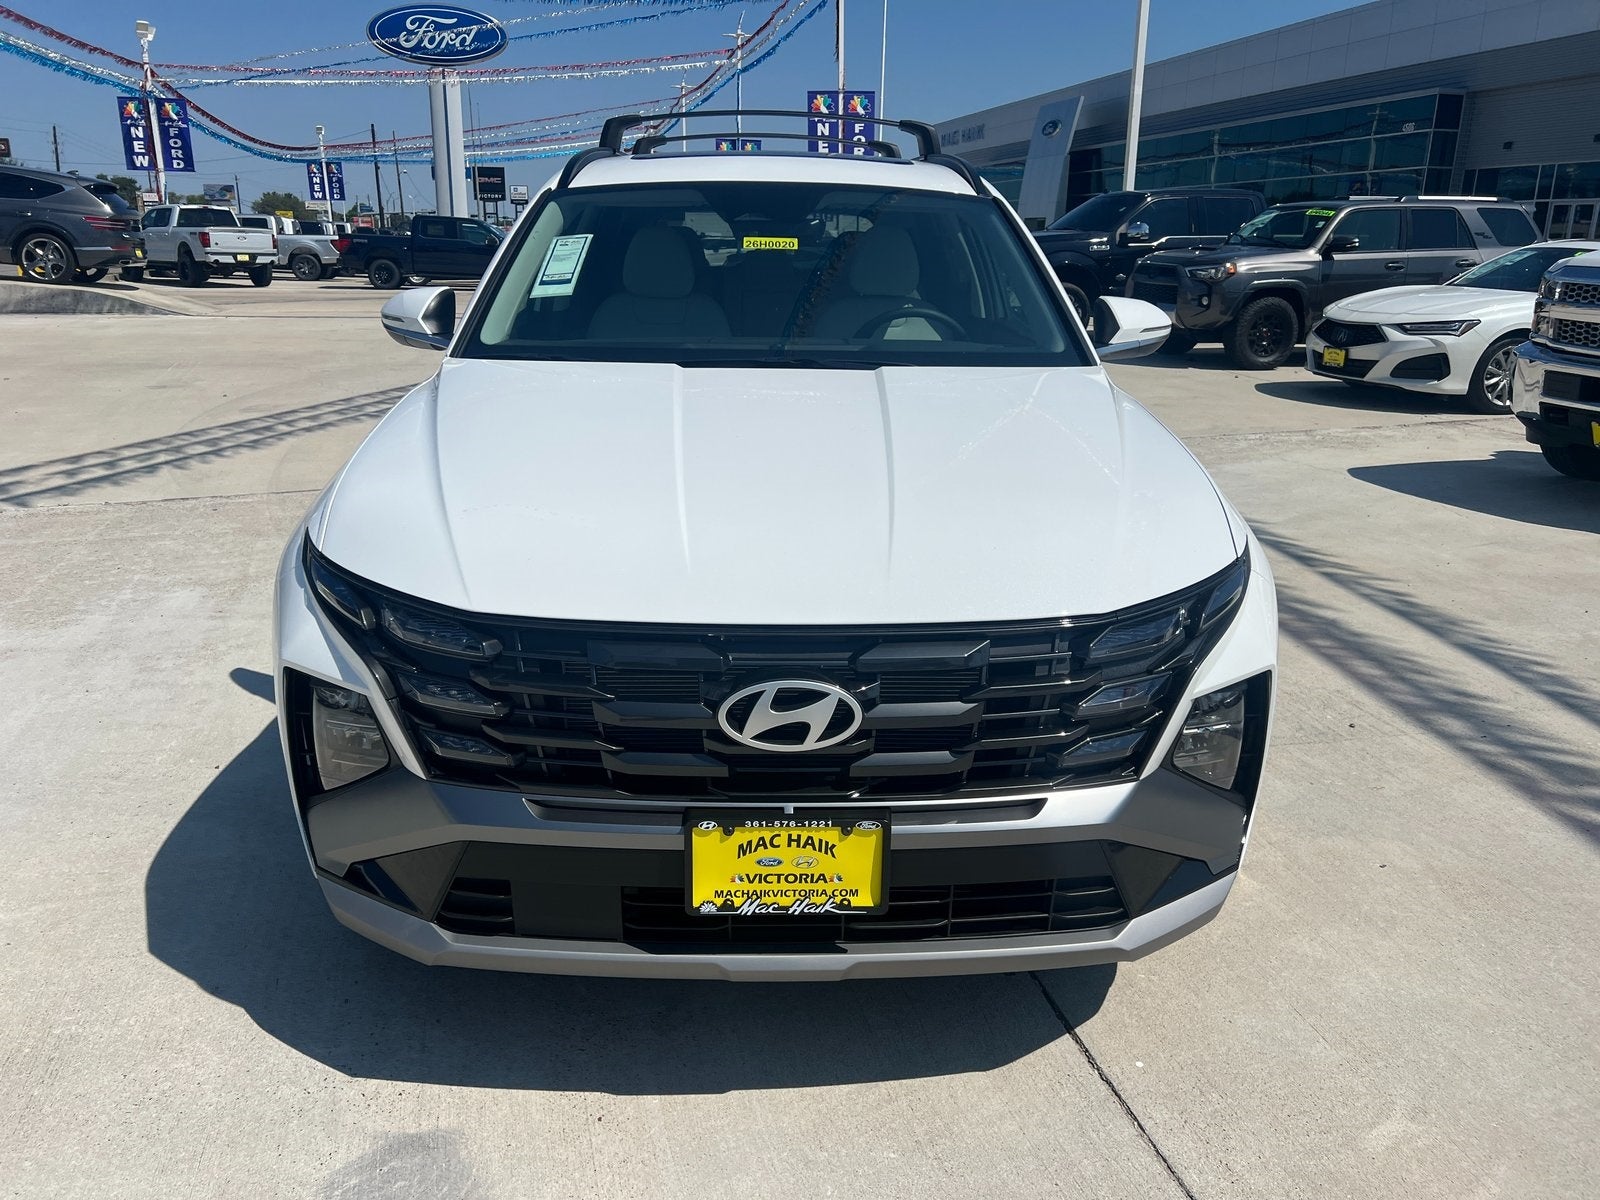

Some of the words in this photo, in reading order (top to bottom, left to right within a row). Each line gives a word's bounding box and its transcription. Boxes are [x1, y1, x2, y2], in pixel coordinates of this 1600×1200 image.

[399, 14, 478, 49] Ford
[130, 126, 149, 167] NEW
[168, 127, 185, 169] FORD
[816, 122, 830, 154] NE
[852, 123, 867, 156] FOR
[312, 176, 323, 199] NEW
[332, 176, 341, 199] FORD
[744, 240, 795, 249] 26H0020
[744, 820, 832, 828] 361-576-1221
[737, 833, 781, 859] MAC
[786, 833, 837, 859] HAIK
[745, 873, 828, 884] VICTORIA
[714, 888, 859, 899] MACHAIKVICTORIA.COM
[737, 896, 783, 915] Mac
[787, 894, 838, 914] Haik
